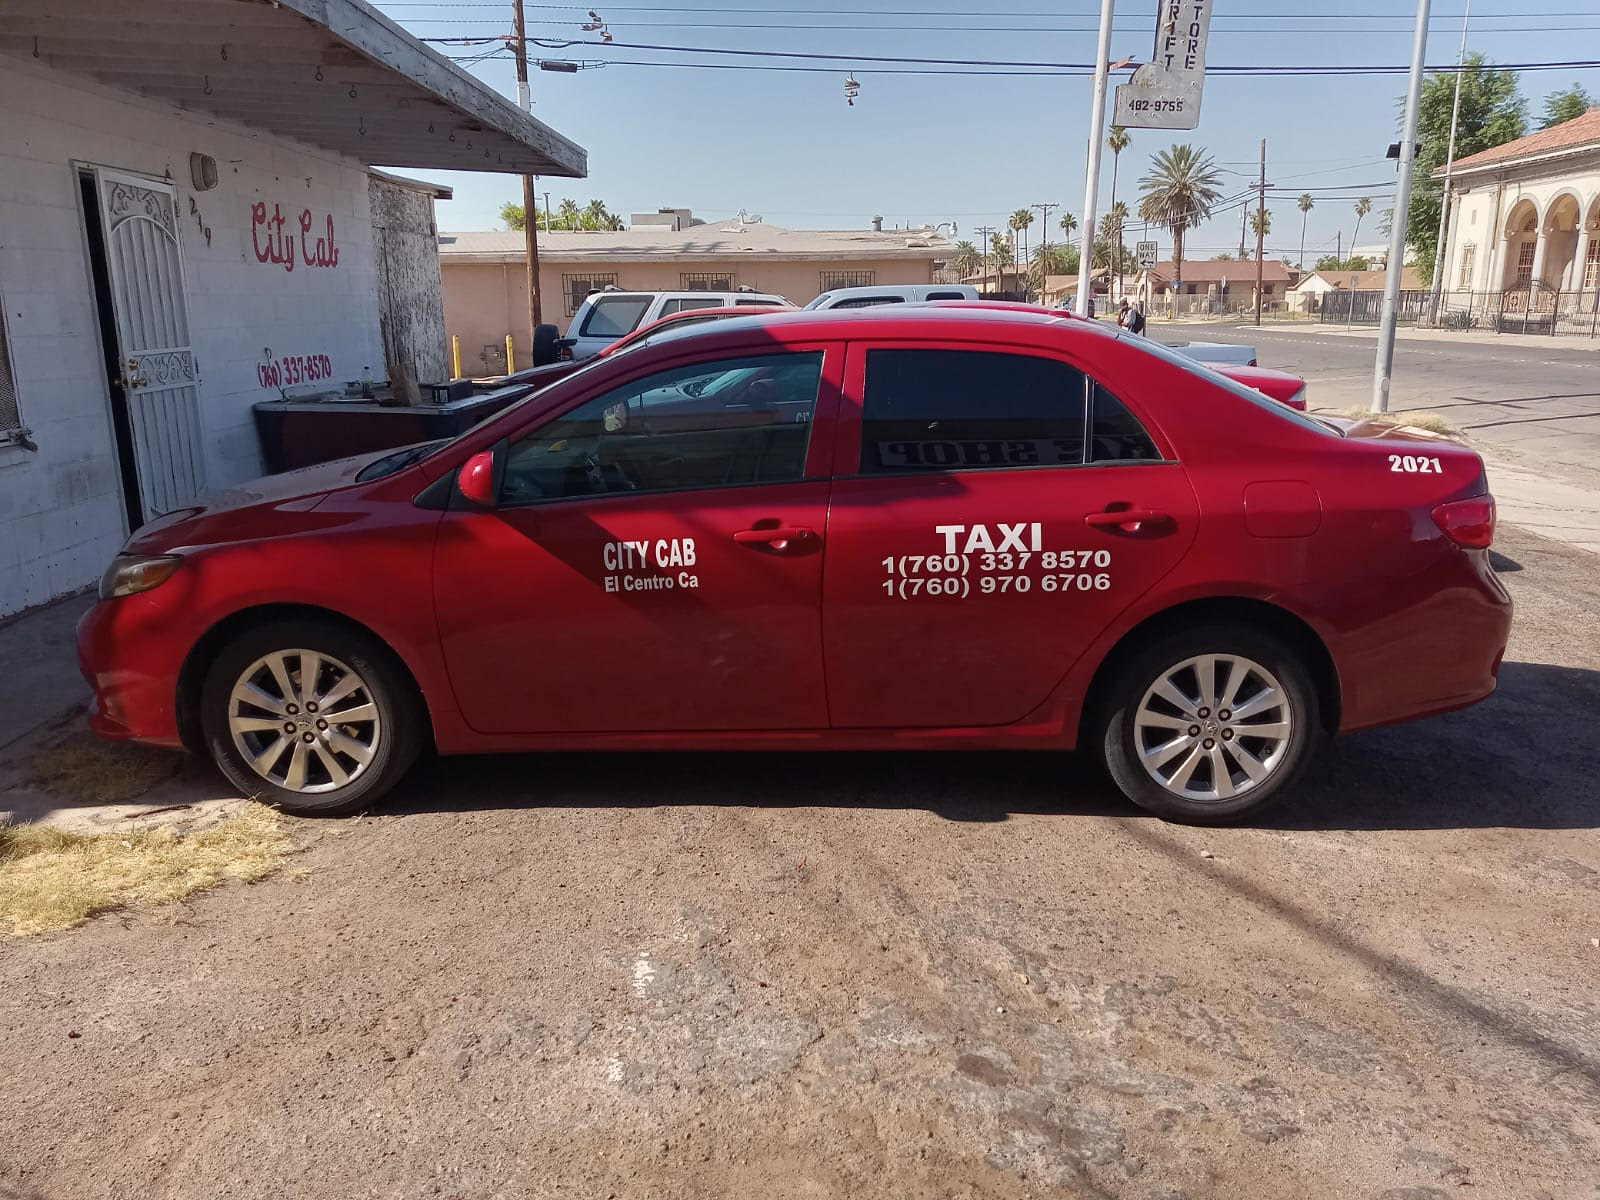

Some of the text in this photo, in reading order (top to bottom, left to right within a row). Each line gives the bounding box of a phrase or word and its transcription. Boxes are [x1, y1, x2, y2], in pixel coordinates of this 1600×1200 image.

[1185, 0, 1203, 70] TORE
[1129, 99, 1184, 112] 482-9755
[251, 202, 295, 272] City
[1139, 243, 1155, 251] ONE
[1139, 251, 1155, 259] WAY
[283, 354, 332, 385] 337-8570
[1388, 454, 1443, 474] 2021
[936, 522, 1042, 554] TAXI
[604, 538, 697, 571] CITY CAB
[881, 550, 1111, 577] 1(760) 337 8570
[604, 571, 699, 592] El Centro Ca
[881, 573, 1111, 600] 1(760) 970 6706
